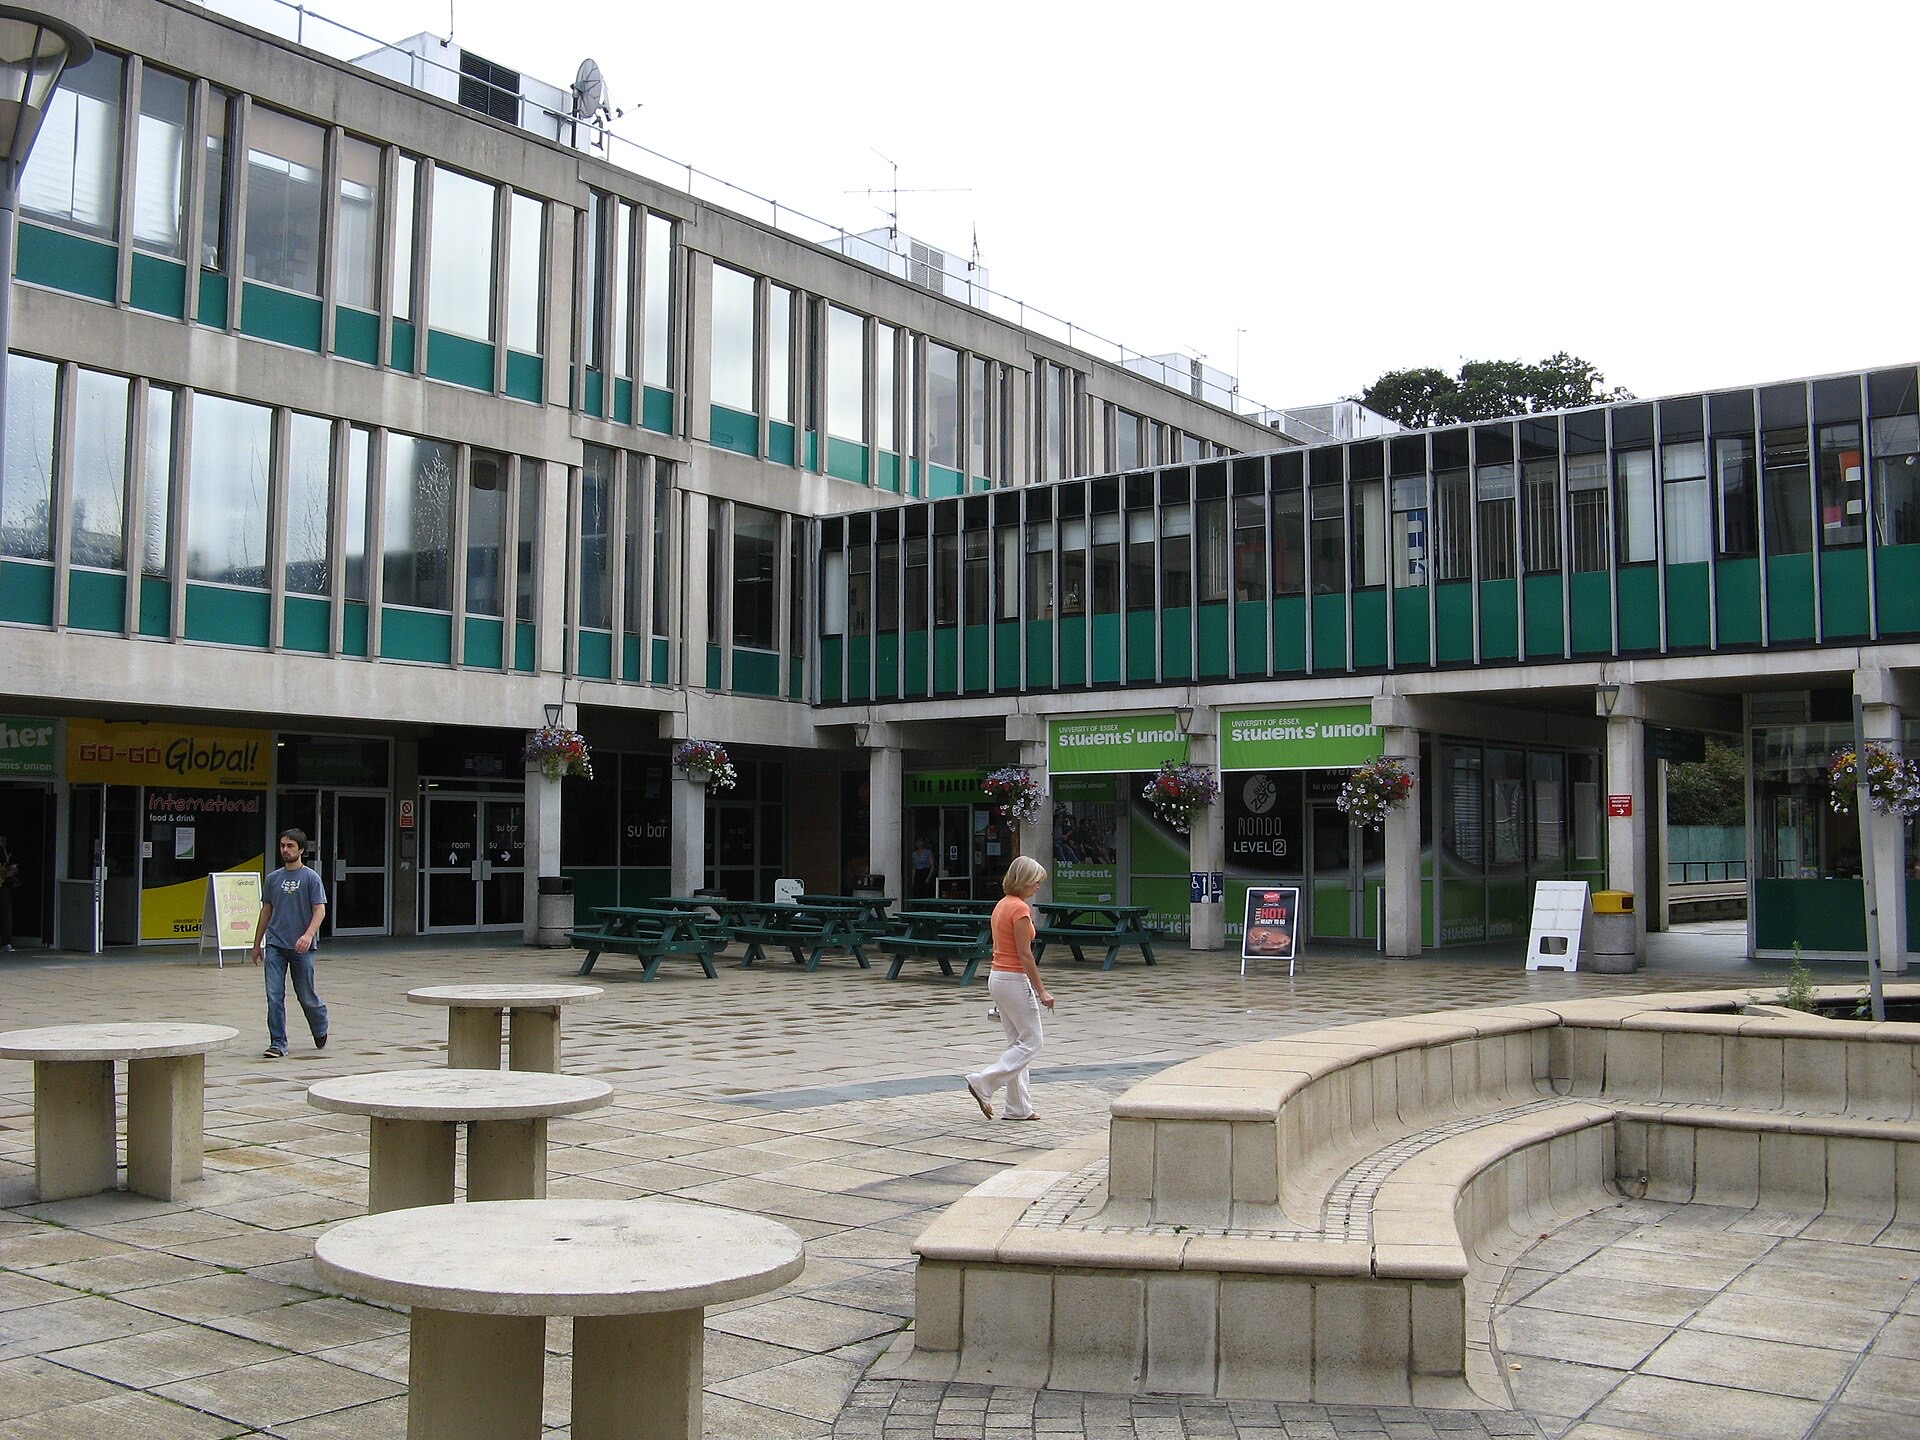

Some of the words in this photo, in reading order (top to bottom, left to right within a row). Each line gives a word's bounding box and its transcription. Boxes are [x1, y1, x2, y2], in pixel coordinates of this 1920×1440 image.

[1231, 719, 1267, 727] UNIVERSITY
[1059, 726, 1089, 734] UNIVERSITY
[1321, 723, 1377, 738] union
[1136, 730, 1185, 743] union
[79, 743, 162, 765] GO-GO
[165, 737, 260, 775] Global!
[24, 762, 52, 771] union
[913, 780, 933, 792] THE
[939, 778, 983, 792] BAKERY
[148, 792, 261, 813] International
[149, 813, 167, 822] food
[168, 813, 174, 822] &
[176, 813, 196, 822] drink
[496, 824, 505, 832] su
[506, 823, 519, 832] bar
[627, 825, 642, 838] su
[647, 822, 668, 838] bar
[1238, 817, 1282, 836] MONDO
[451, 841, 471, 849] room
[489, 841, 498, 849] su
[1233, 841, 1272, 853] LEVEL
[1274, 841, 1284, 853] 2
[1057, 860, 1073, 868] we
[1056, 869, 1112, 879] represent.
[1261, 907, 1286, 919] HOT!
